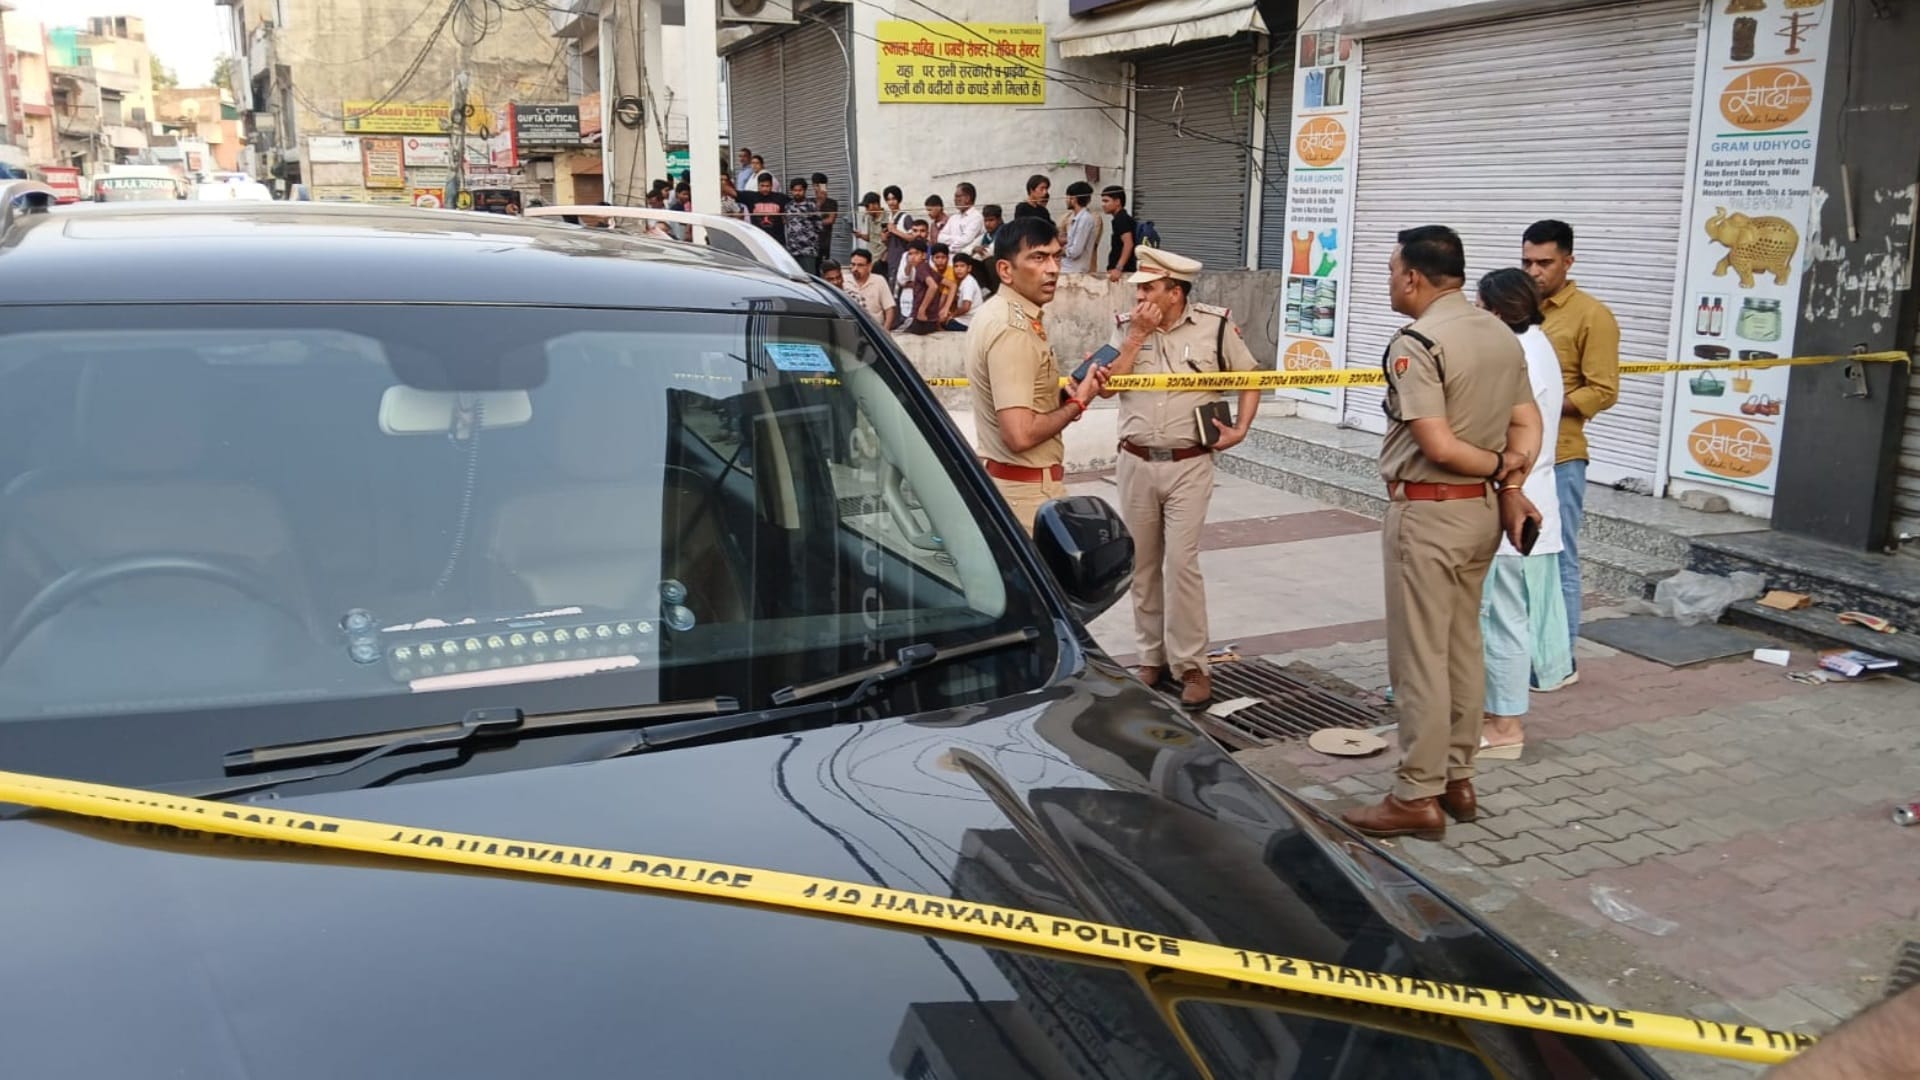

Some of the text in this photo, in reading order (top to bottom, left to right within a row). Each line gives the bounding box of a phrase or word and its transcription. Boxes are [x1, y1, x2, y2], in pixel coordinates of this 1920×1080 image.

[545, 114, 578, 123] OPTICAL
[1711, 139, 1812, 152] GRAM UDHYOG
[1716, 159, 1741, 167] Natural
[1749, 158, 1776, 167] Organic
[1778, 158, 1809, 166] Products
[1704, 169, 1720, 177] Have
[1767, 169, 1780, 177] you
[1782, 168, 1800, 176] Wide
[1725, 179, 1732, 187] of
[1106, 377, 1156, 388] 112 HARYAN
[1166, 376, 1249, 387] 112 HARYANA POLICE
[1258, 374, 1340, 386] 112 HARYANA POLICE
[1349, 373, 1377, 384] POLICE
[870, 892, 1039, 933] HARYANA
[1052, 920, 1181, 957] POLICE
[1234, 950, 1635, 1029] 112 HARYANA POLICE
